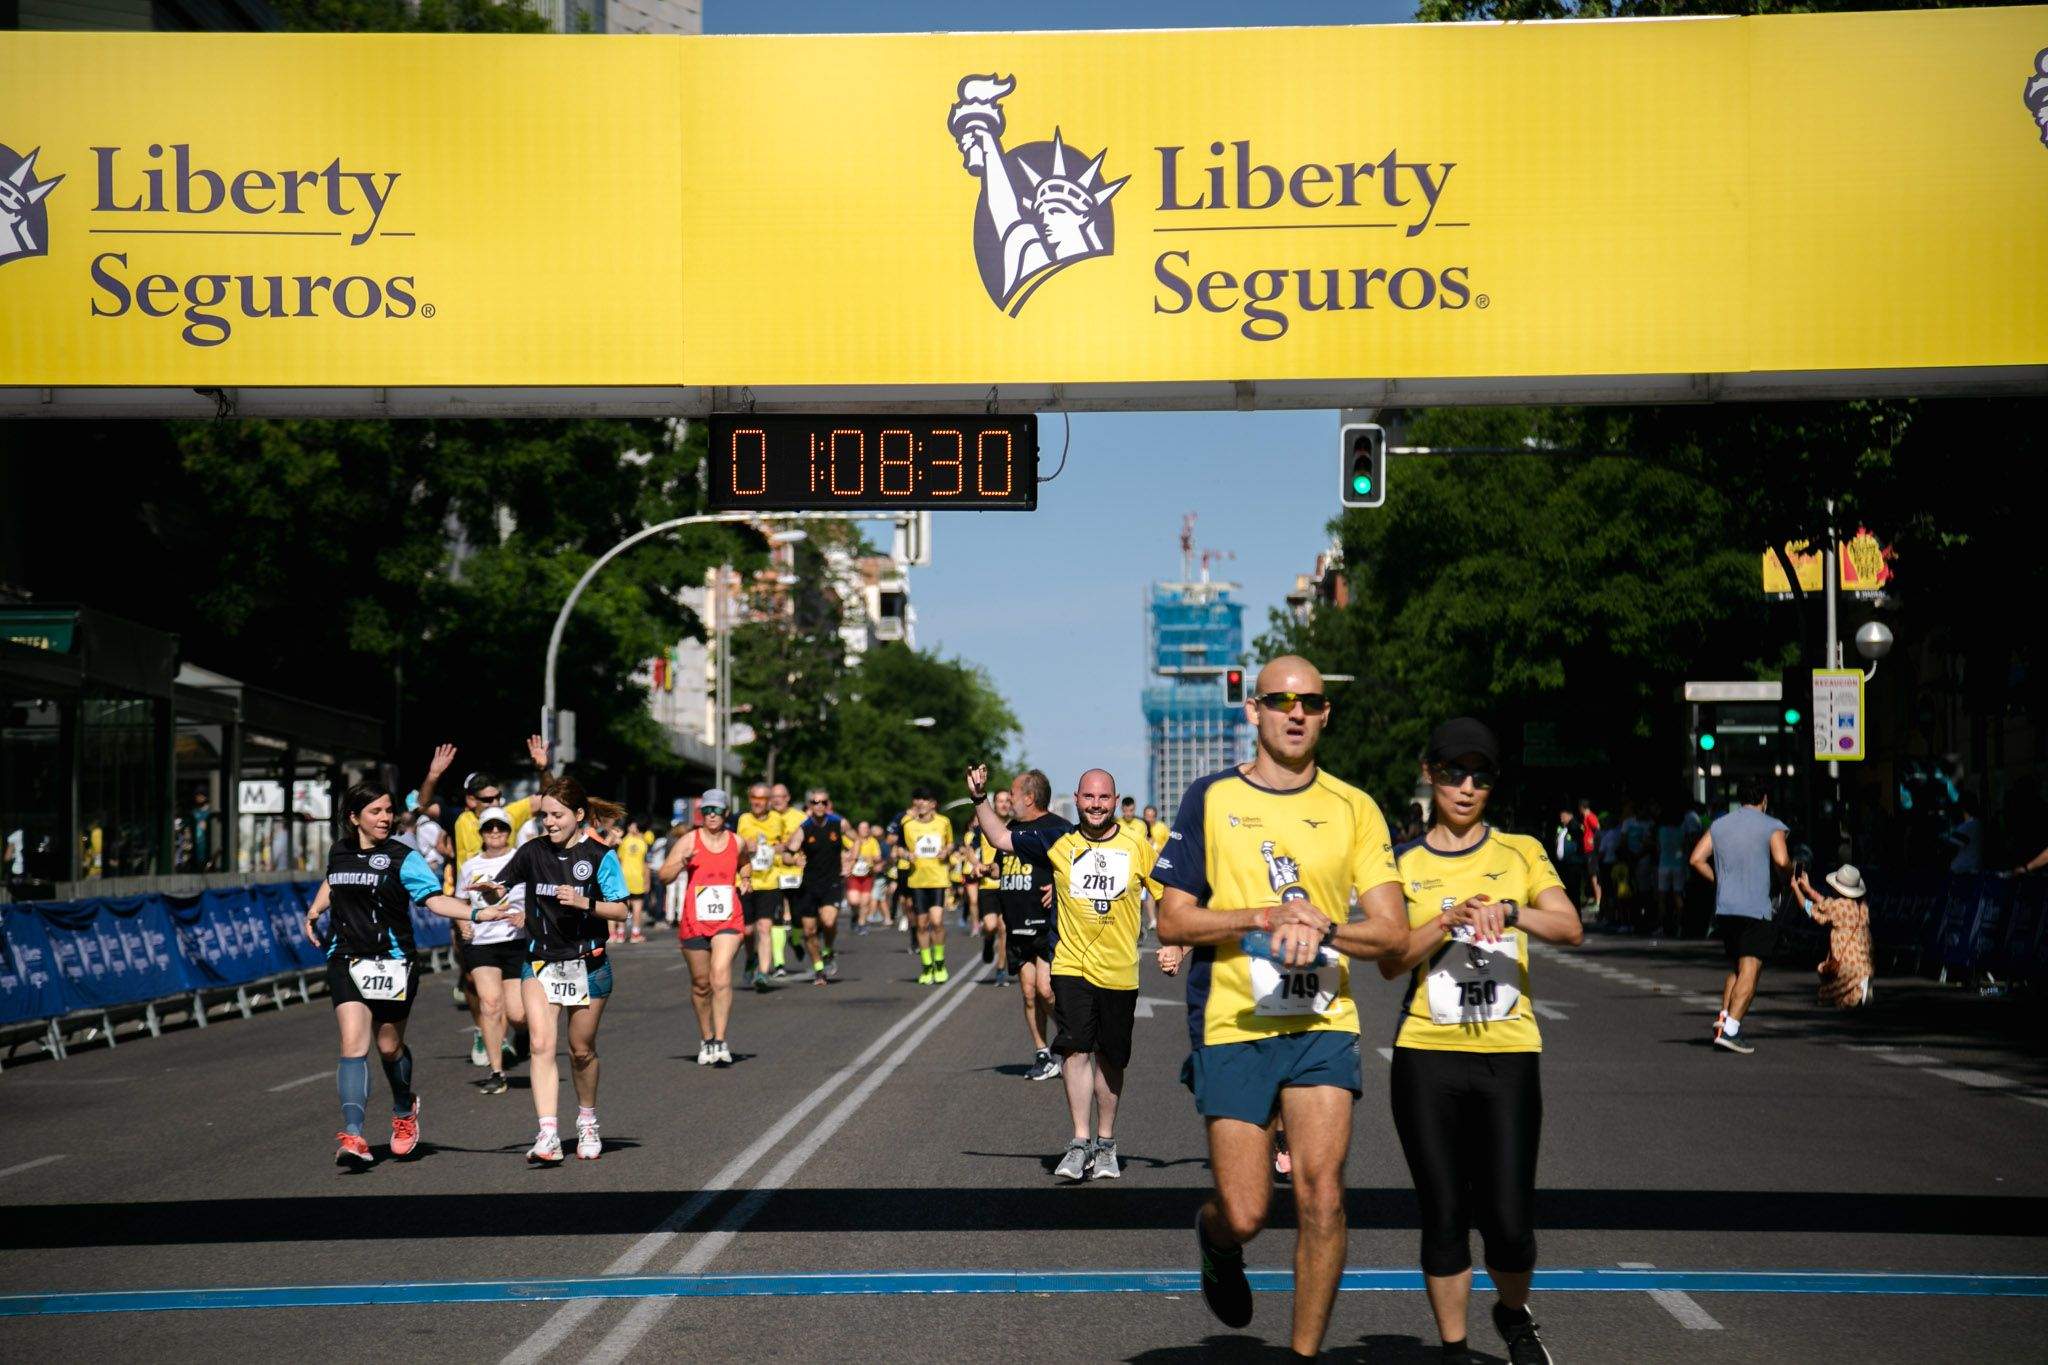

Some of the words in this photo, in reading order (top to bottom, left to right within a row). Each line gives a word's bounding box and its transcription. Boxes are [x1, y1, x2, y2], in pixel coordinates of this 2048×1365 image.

[89, 143, 402, 245] Liberty
[1154, 140, 1458, 237] Liberty
[1083, 875, 1115, 890] 2781
[708, 903, 724, 914] 129
[1097, 901, 1108, 911] 13
[362, 975, 393, 991] 2174
[1280, 973, 1320, 1000] 749
[1456, 979, 1498, 1007] 750
